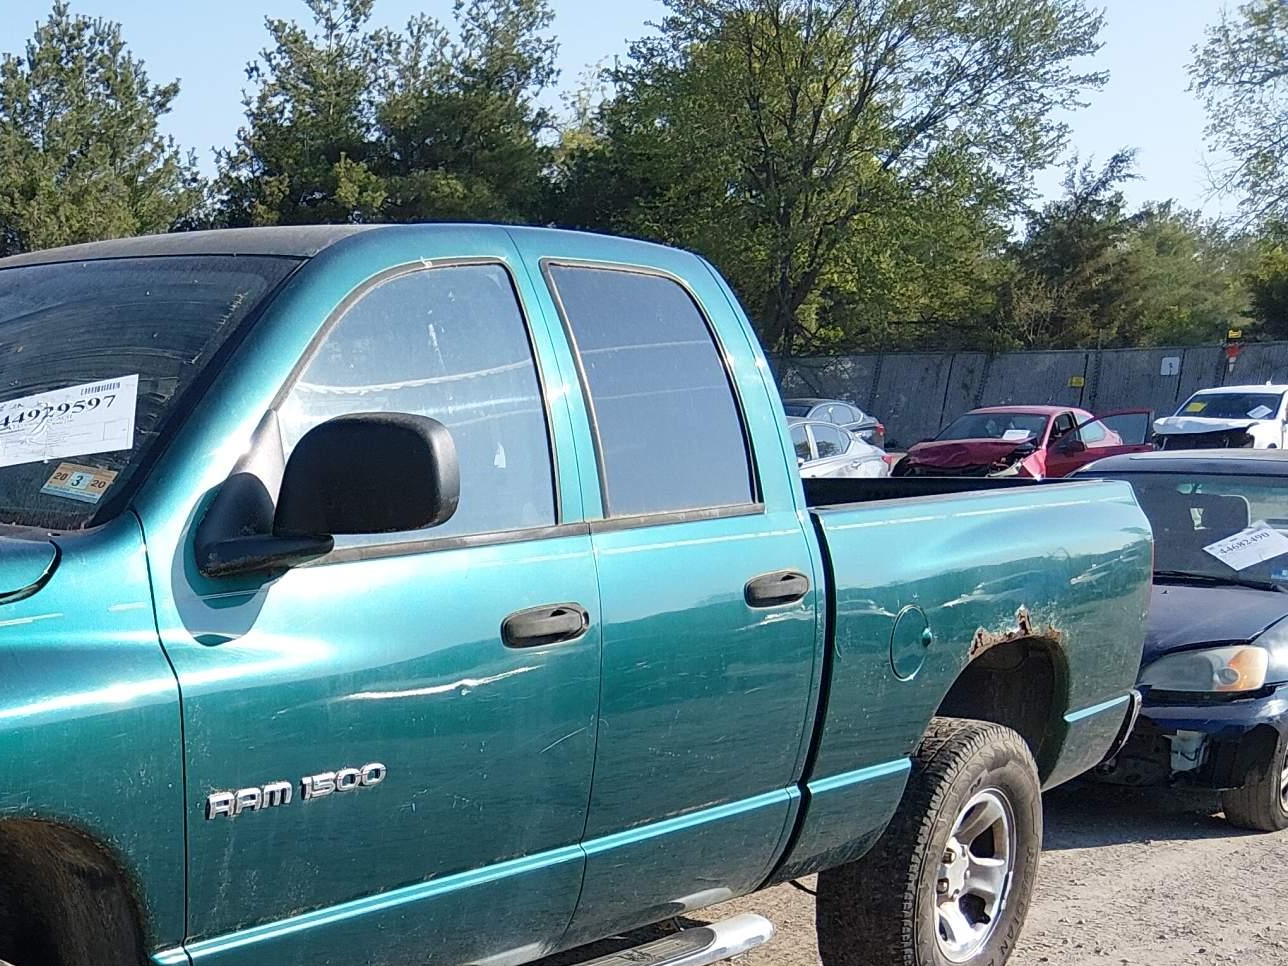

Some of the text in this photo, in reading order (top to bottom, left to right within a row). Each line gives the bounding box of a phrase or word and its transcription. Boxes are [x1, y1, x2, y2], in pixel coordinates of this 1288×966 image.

[53, 472, 106, 489] 20 3 20
[205, 761, 387, 820] RAM 1500
